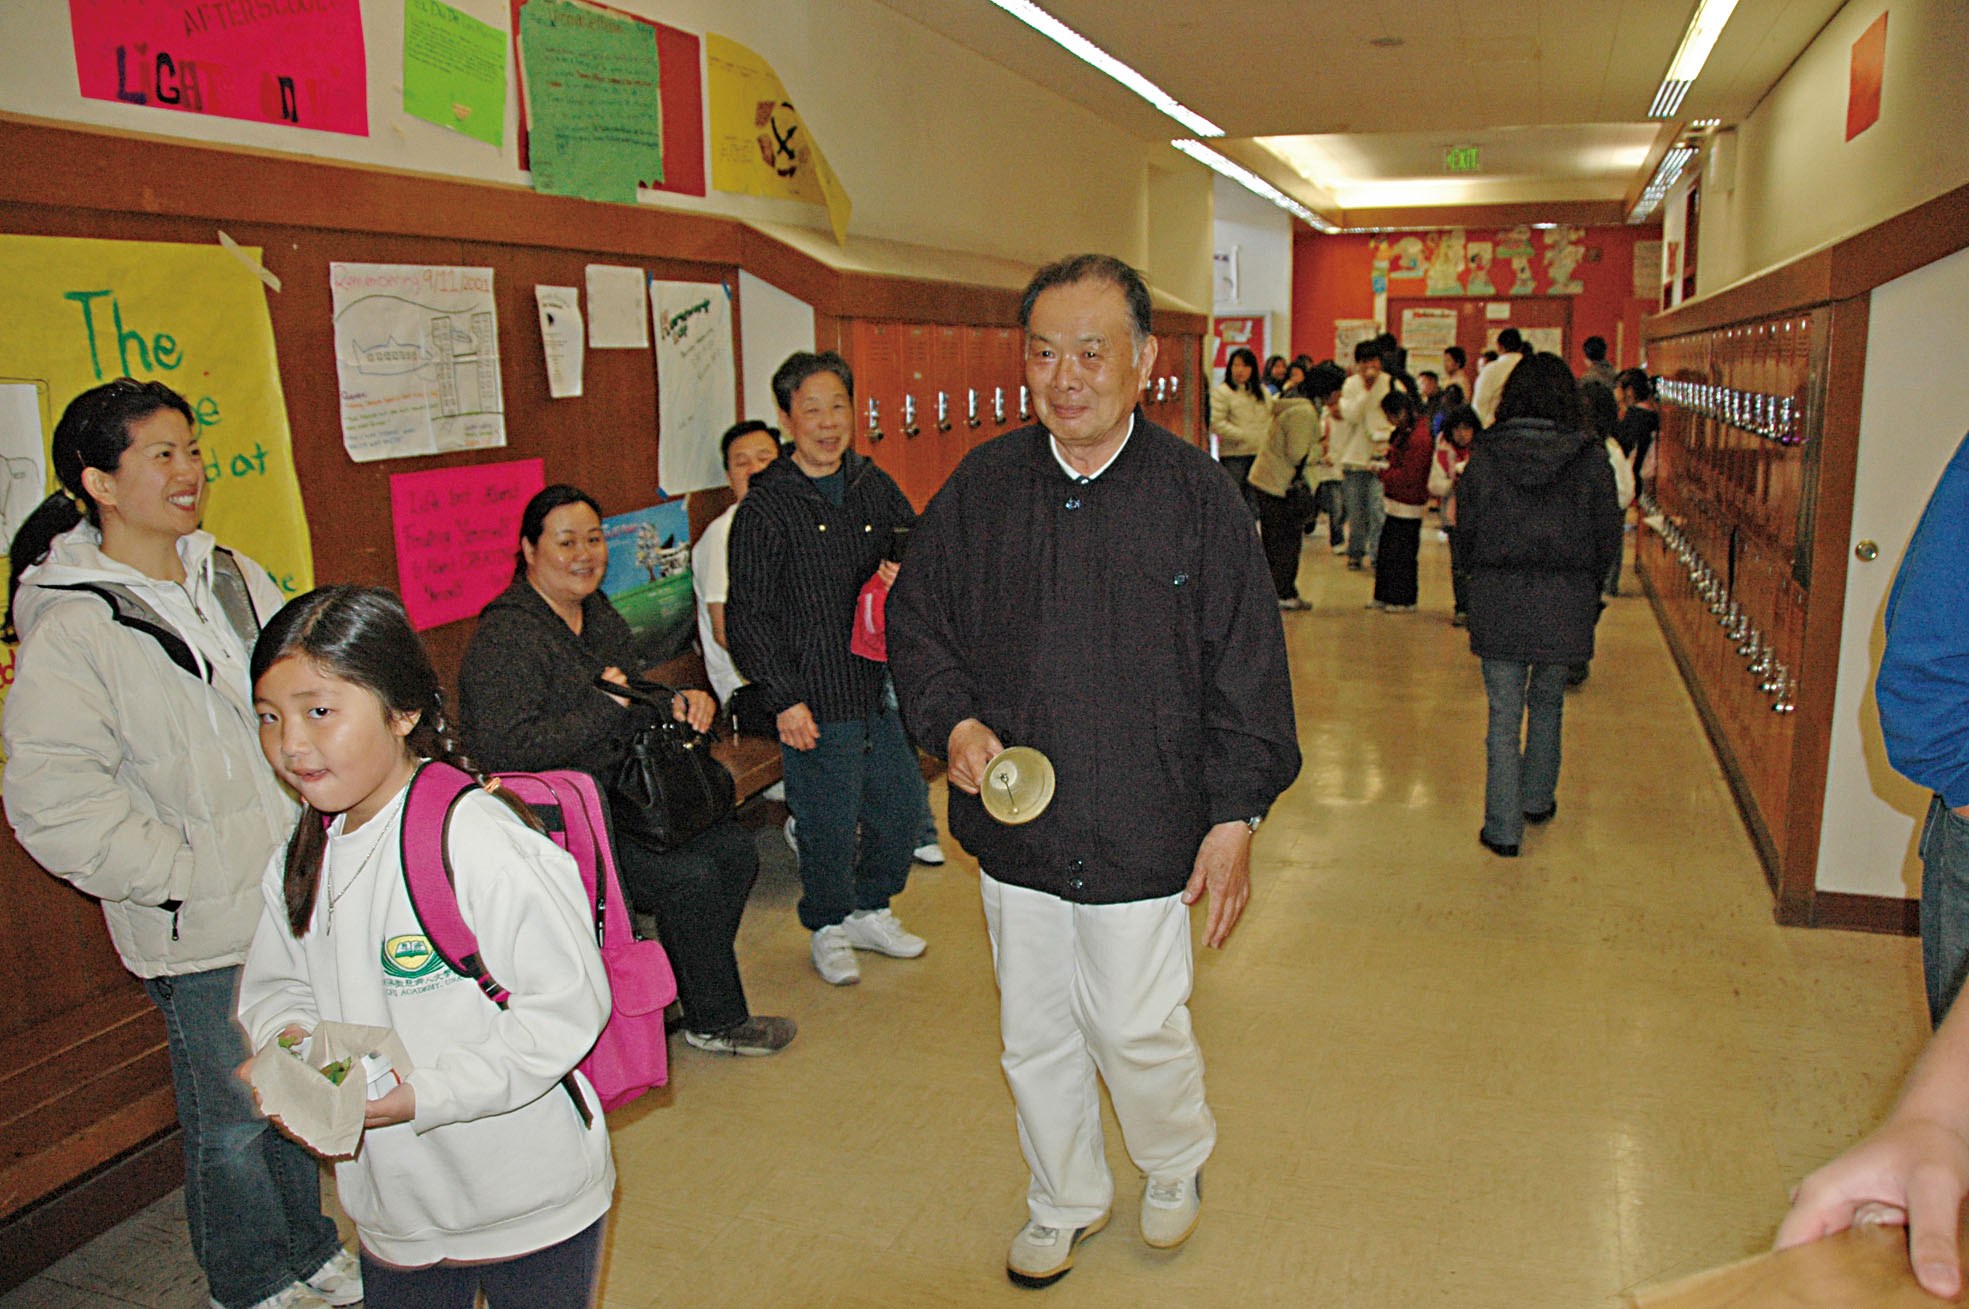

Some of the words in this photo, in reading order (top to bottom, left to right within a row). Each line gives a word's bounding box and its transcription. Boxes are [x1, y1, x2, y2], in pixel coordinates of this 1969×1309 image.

[1451, 147, 1478, 170] EXIT
[63, 289, 184, 380] The
[231, 442, 268, 477] at
